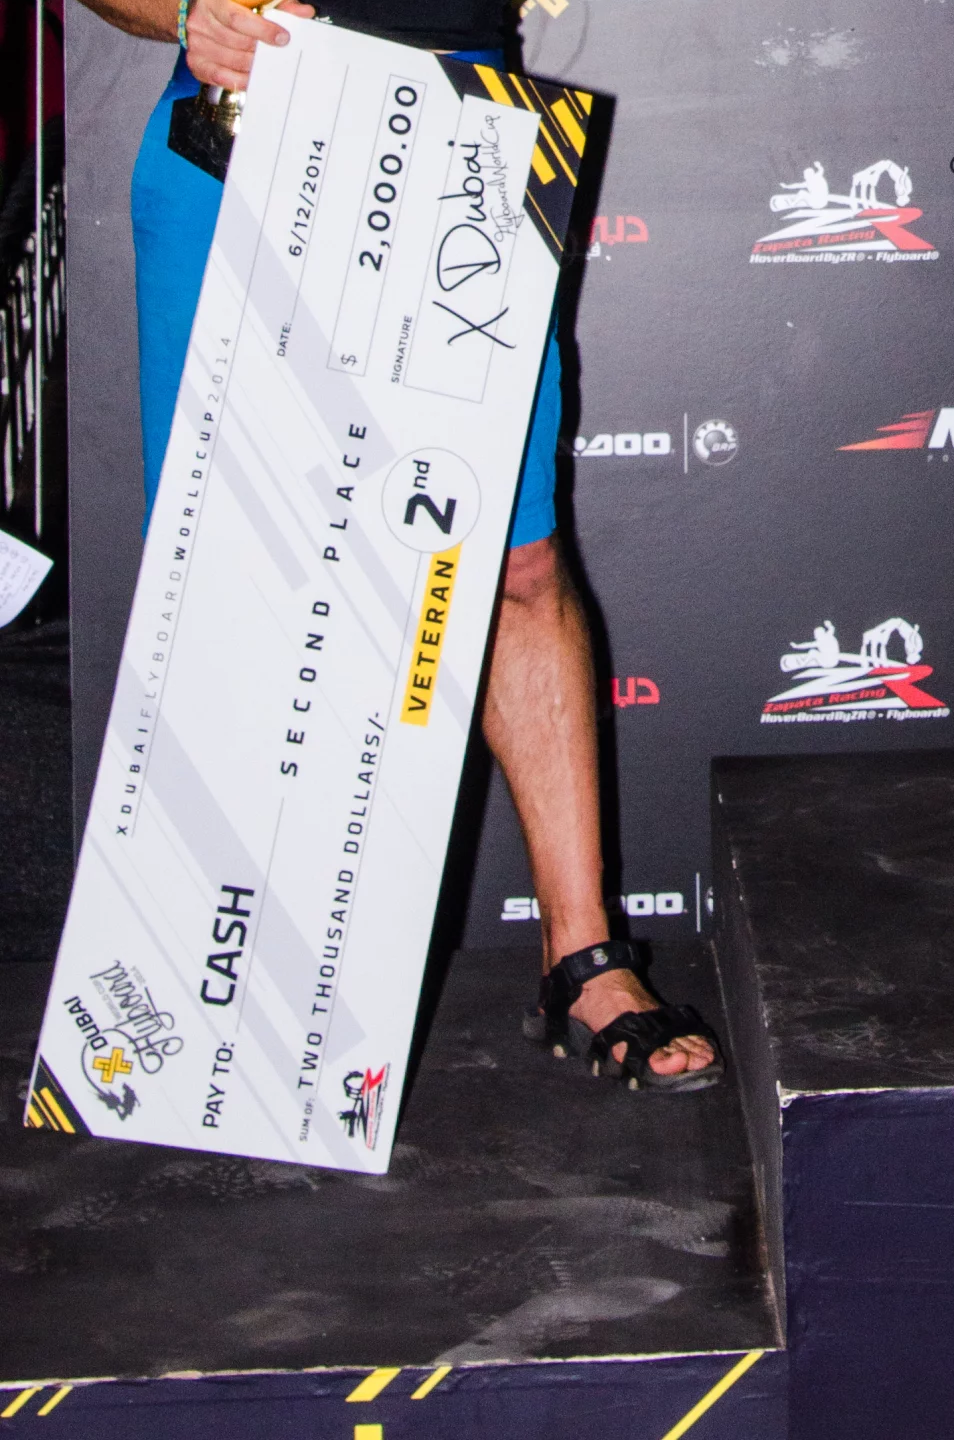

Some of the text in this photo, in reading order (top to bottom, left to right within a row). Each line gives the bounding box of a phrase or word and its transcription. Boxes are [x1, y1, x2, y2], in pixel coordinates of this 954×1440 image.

[288, 138, 326, 258] 6/12/2014
[358, 85, 420, 272] 2,000.00
[276, 320, 294, 358] DATE:
[340, 353, 360, 368] $
[390, 314, 414, 384] SIGNATURE
[280, 423, 367, 777] SECOND PLACE
[408, 560, 456, 713] VETERAN
[200, 884, 255, 1006] CASH
[297, 711, 386, 1089] TWO THOUSAND DOLLARS/-
[64, 996, 108, 1050] DUBAI
[203, 1042, 235, 1129] PAY TO:
[299, 1120, 312, 1142] SUM
